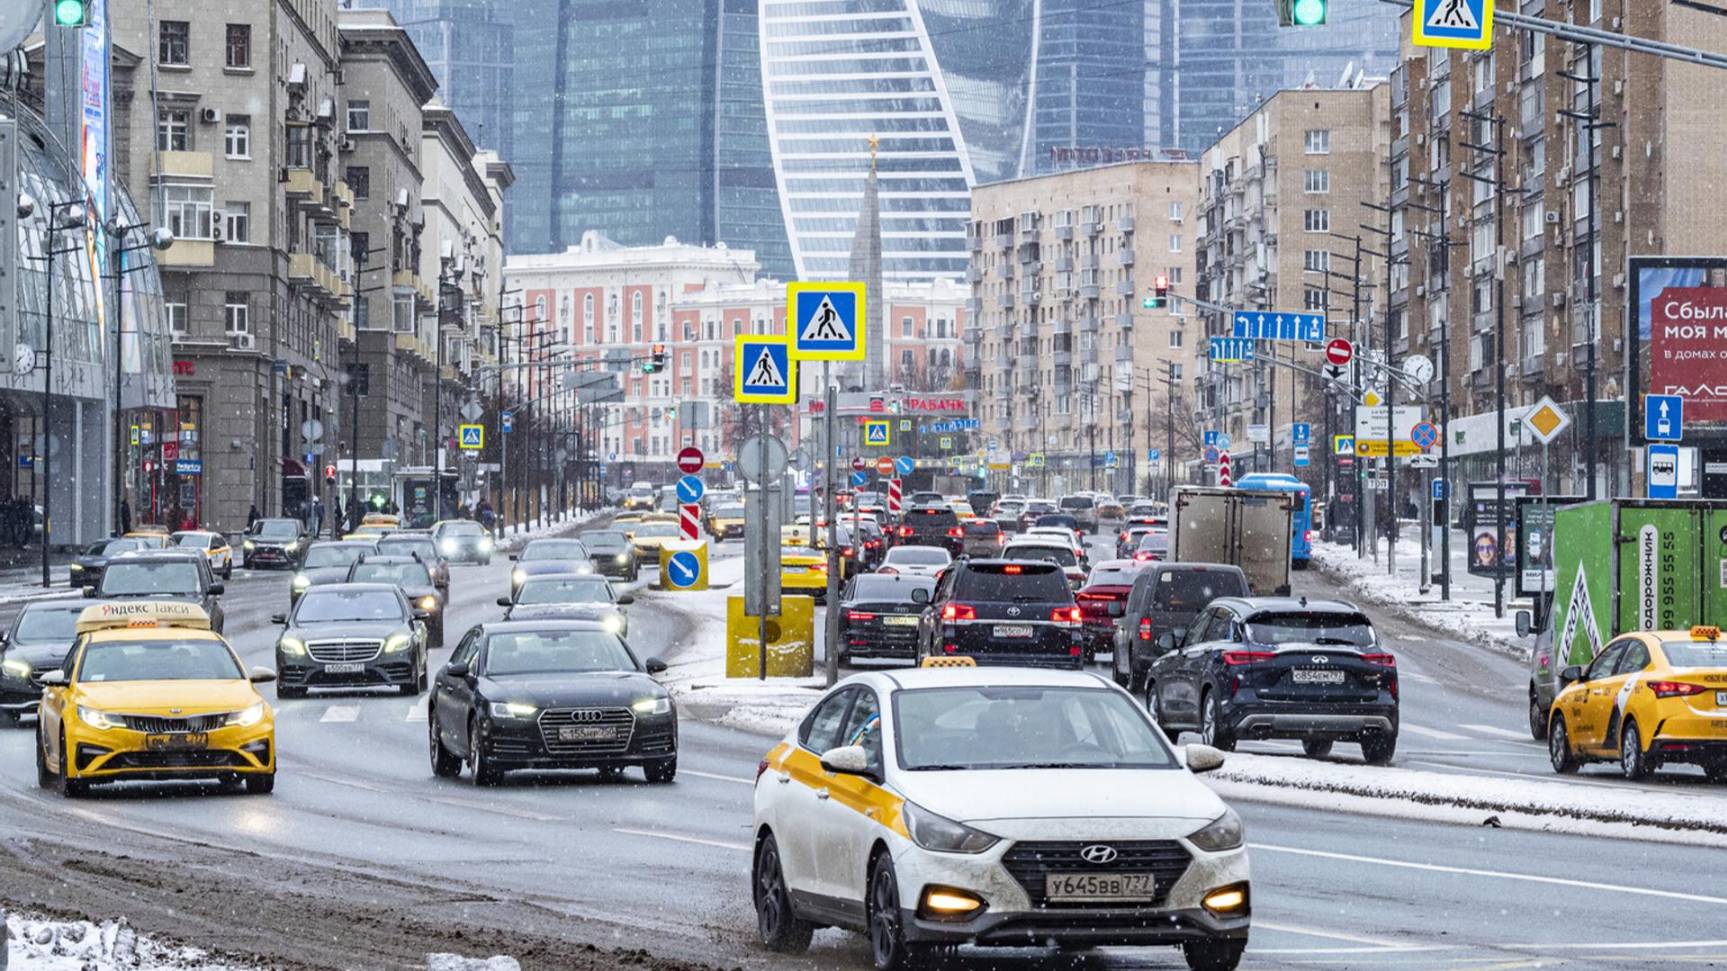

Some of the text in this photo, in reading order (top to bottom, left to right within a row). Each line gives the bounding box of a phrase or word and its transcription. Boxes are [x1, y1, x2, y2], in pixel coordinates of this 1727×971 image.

[1664, 325, 1707, 339] моя
[1675, 349, 1716, 361] домах
[1663, 531, 1674, 550] 55
[1663, 554, 1674, 572] 55
[1643, 532, 1655, 631] одорожник
[1663, 577, 1674, 606] 955
[102, 603, 190, 616] Яндекс Такси
[1053, 875, 1150, 894] У645ВВ 777
